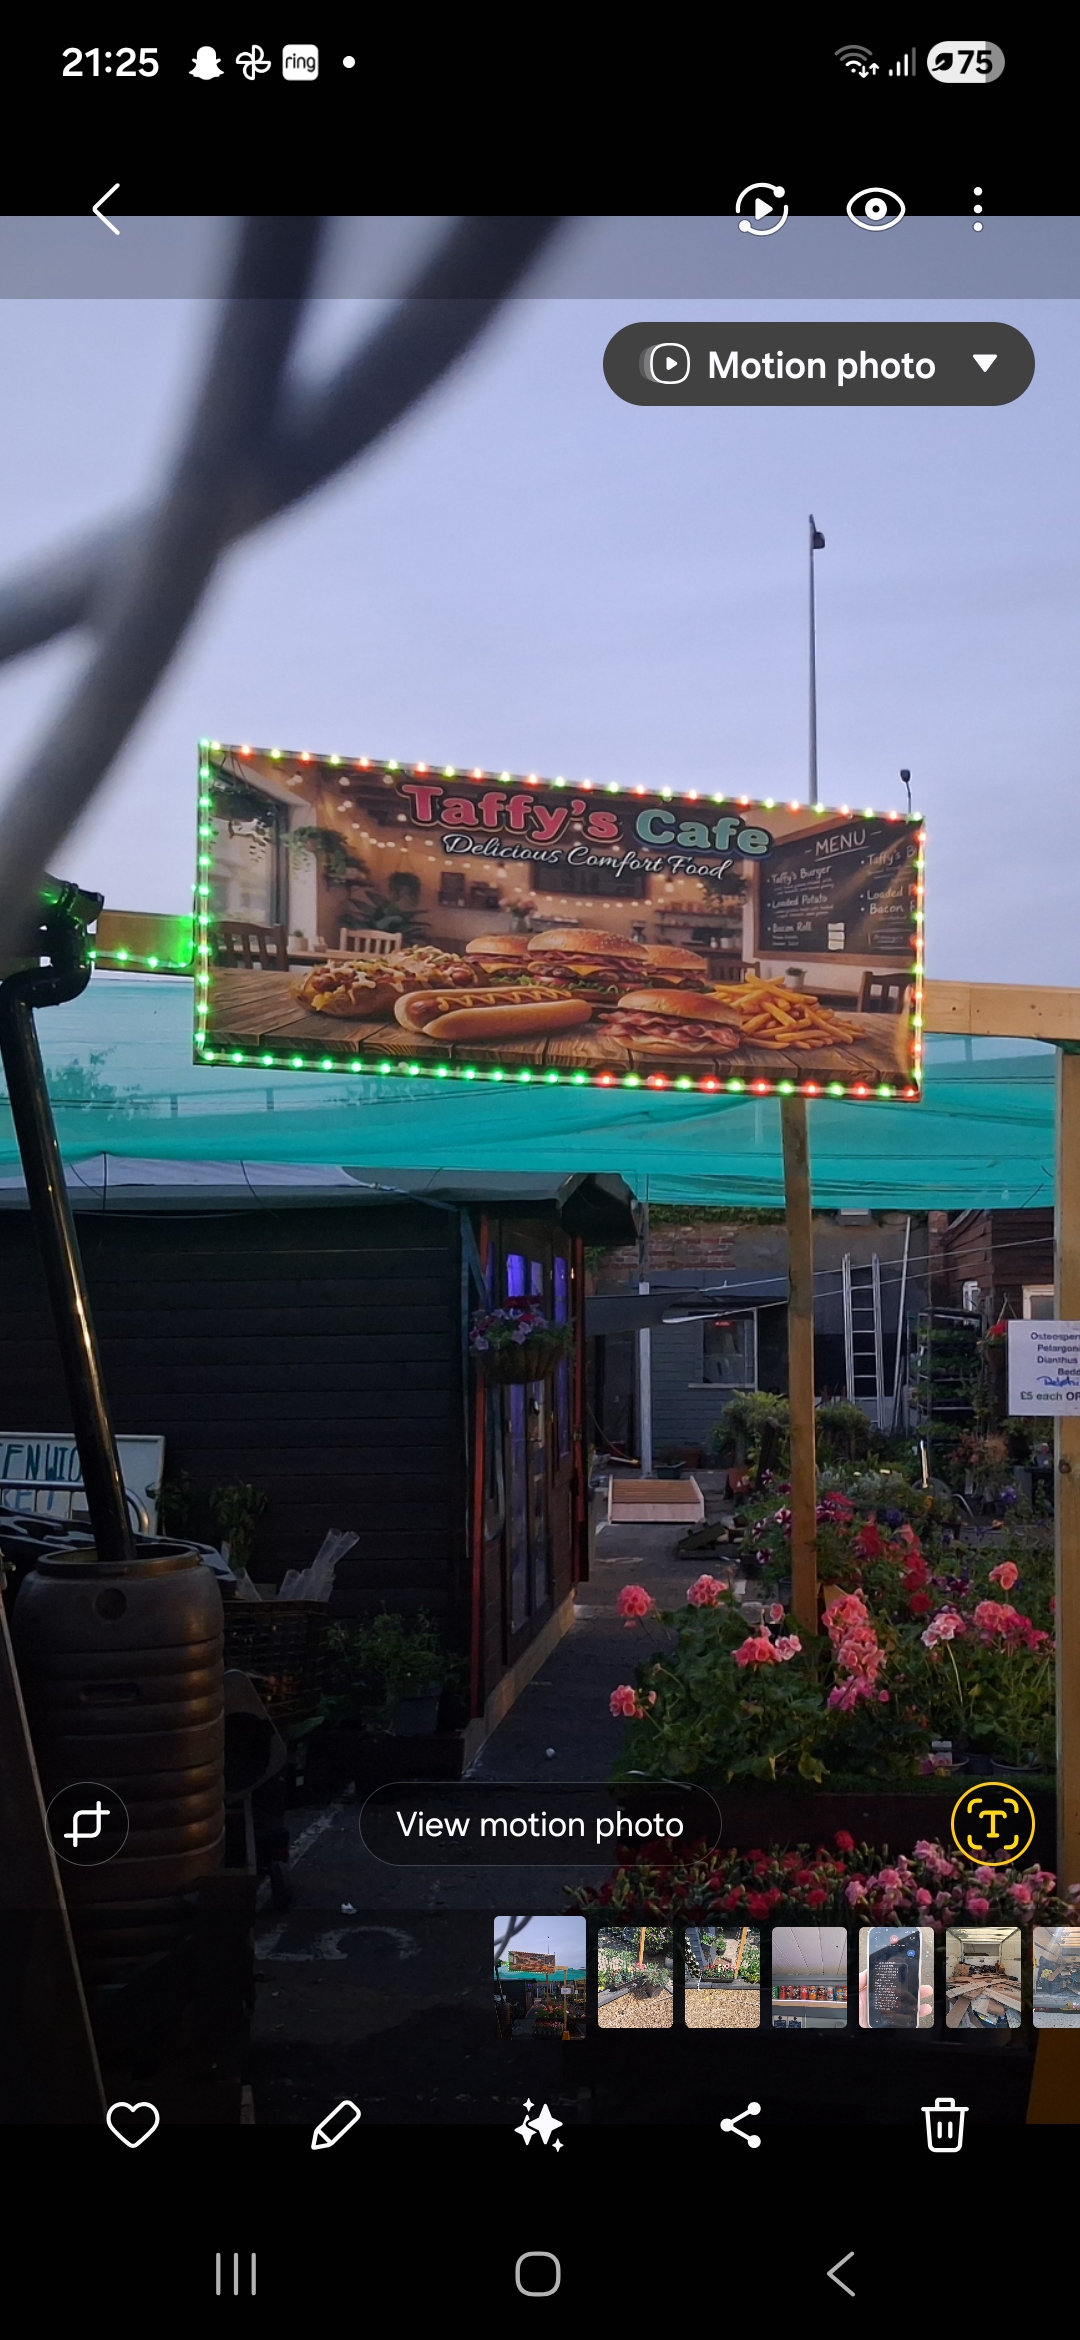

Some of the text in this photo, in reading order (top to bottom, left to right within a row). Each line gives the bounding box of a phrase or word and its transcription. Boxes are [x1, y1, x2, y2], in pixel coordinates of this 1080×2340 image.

[401, 784, 771, 855] Taffy's Cafe
[815, 829, 866, 856] MENU
[442, 834, 734, 880] Delicious Comfort Food
[866, 851, 901, 866] Taffy's
[800, 866, 832, 880] Burger
[867, 886, 903, 900] Loaded
[772, 893, 828, 909] Loaded Potato
[869, 902, 904, 915] Bacon
[1036, 1392, 1062, 1400] each
